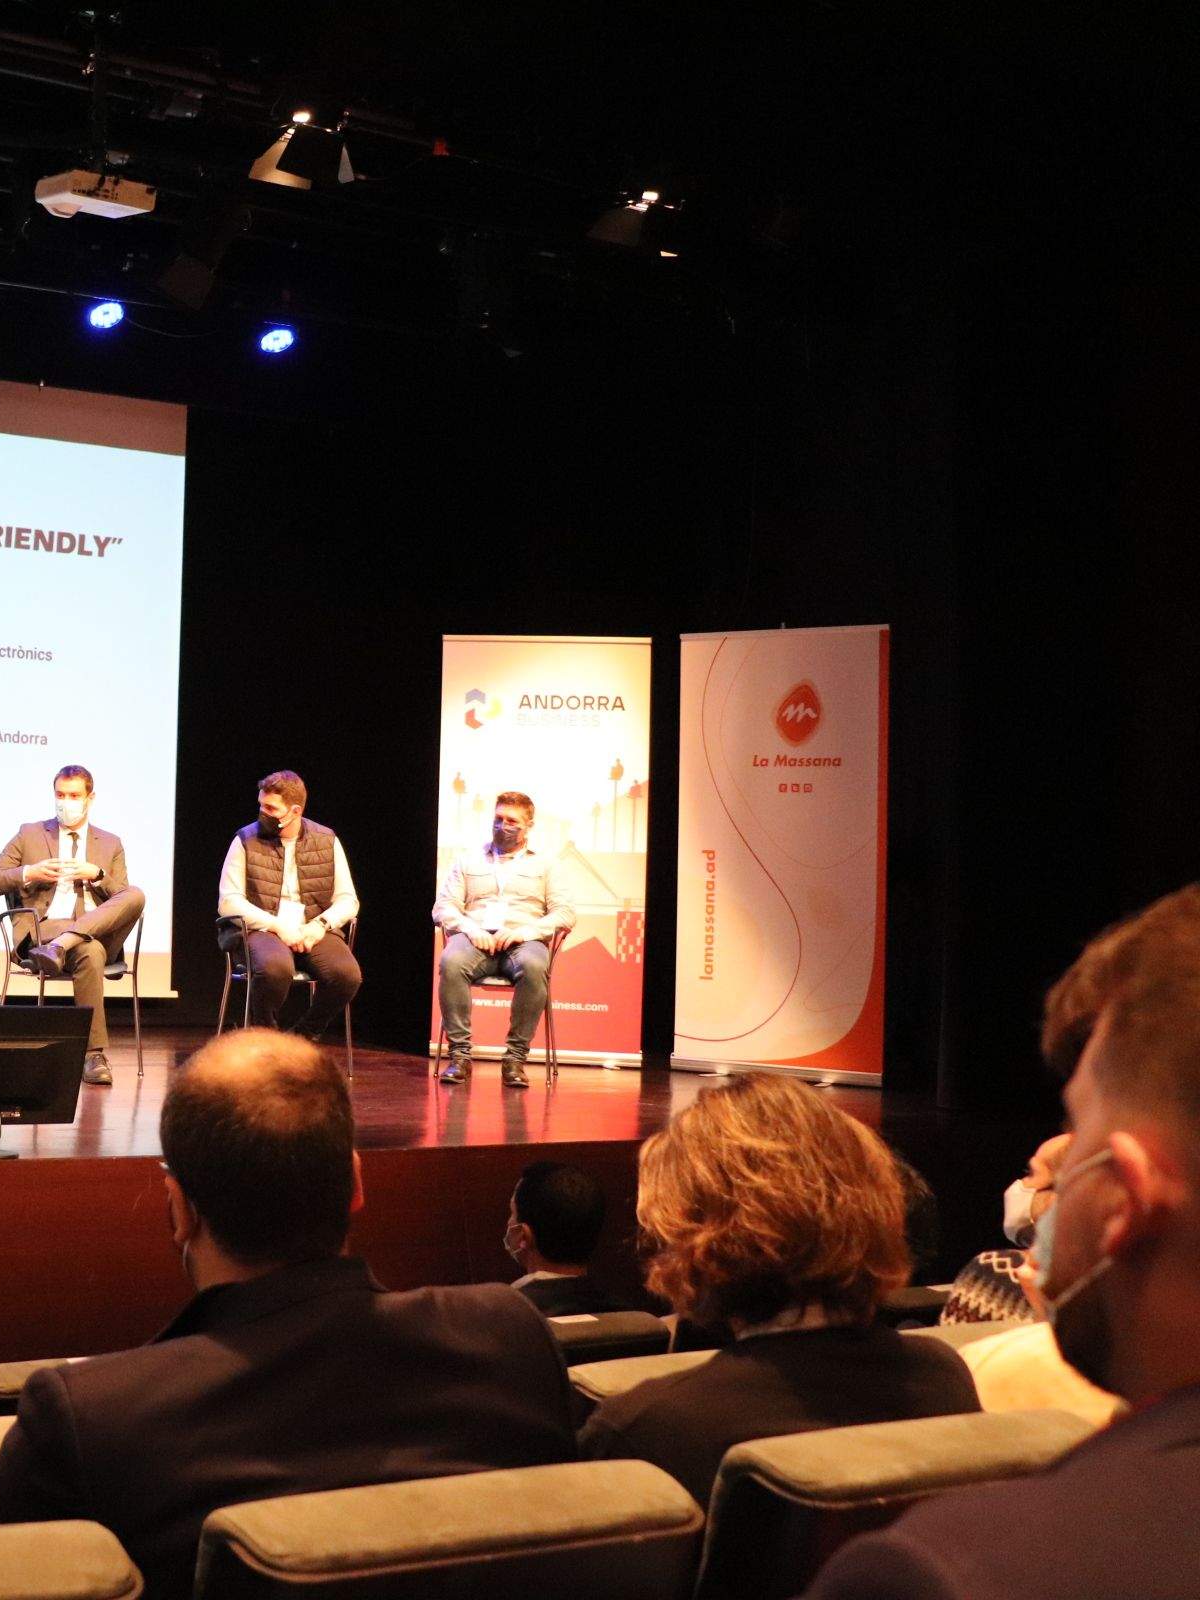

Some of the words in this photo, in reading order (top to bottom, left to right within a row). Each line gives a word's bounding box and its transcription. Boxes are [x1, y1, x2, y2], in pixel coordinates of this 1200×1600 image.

[518, 694, 626, 711] ANDORRA
[752, 754, 769, 767] La
[774, 754, 842, 767] Massana
[699, 849, 716, 980] lamassana.ad
